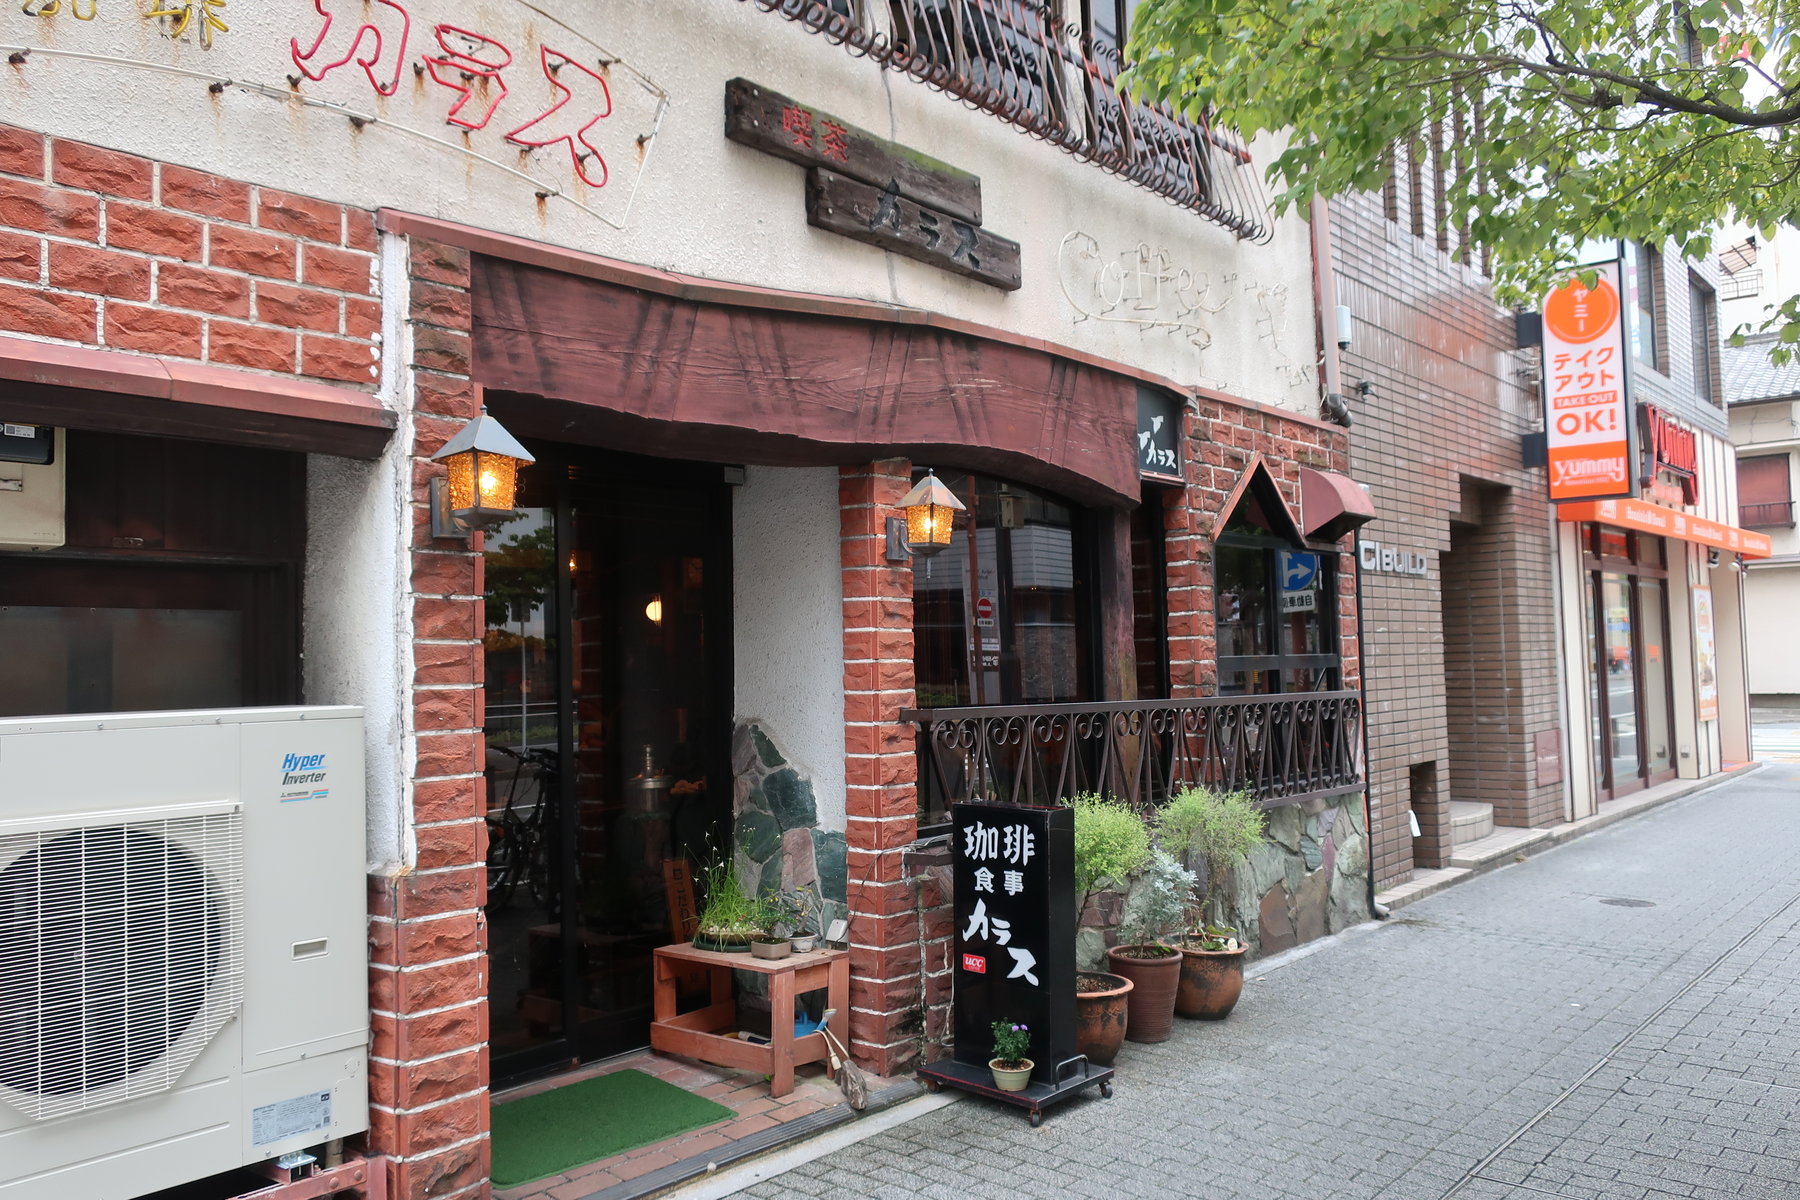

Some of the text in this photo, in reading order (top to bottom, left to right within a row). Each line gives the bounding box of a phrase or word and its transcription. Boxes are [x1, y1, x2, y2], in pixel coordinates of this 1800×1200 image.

[781, 104, 849, 163] 喫茶
[869, 176, 982, 271] カラス
[1572, 289, 1589, 332] ヤミー
[1554, 346, 1615, 372] テイク
[1554, 368, 1616, 393] アウト
[1556, 391, 1615, 408] TAKE OUT
[1556, 408, 1617, 436] OK!
[1146, 439, 1177, 469] カラス
[1552, 456, 1625, 487] yummy
[282, 753, 326, 771] Hyper
[282, 772, 327, 785] Inverter
[963, 820, 1036, 867] 珈琲
[973, 867, 1025, 896] 食事
[962, 897, 1040, 987] カラス
